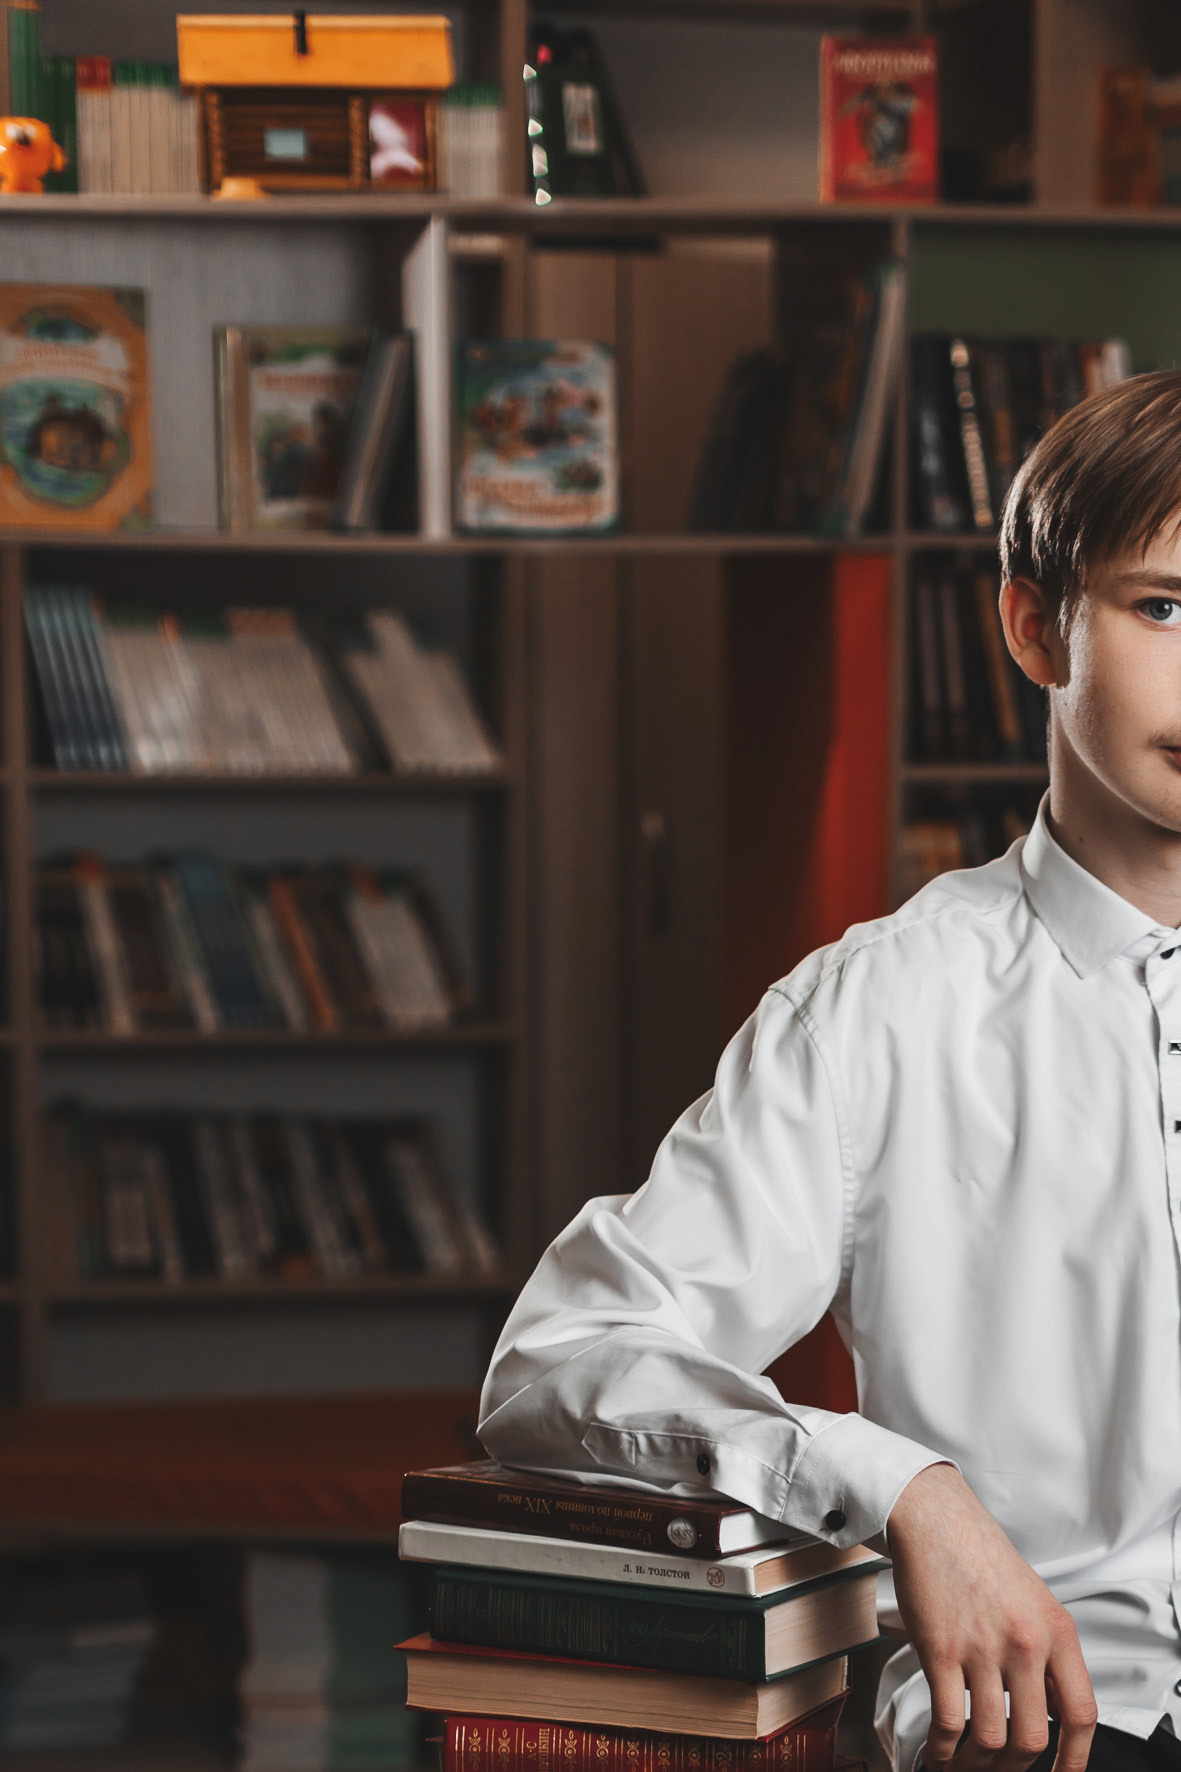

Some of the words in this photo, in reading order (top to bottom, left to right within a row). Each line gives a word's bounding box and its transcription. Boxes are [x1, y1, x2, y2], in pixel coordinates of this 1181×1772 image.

[497, 1492, 523, 1505] века
[524, 1496, 553, 1514] XIX
[556, 1500, 611, 1517] половины
[613, 1507, 653, 1523] первой
[569, 1521, 600, 1538] проза
[606, 1526, 652, 1546] Русская
[623, 1564, 632, 1573] Л.
